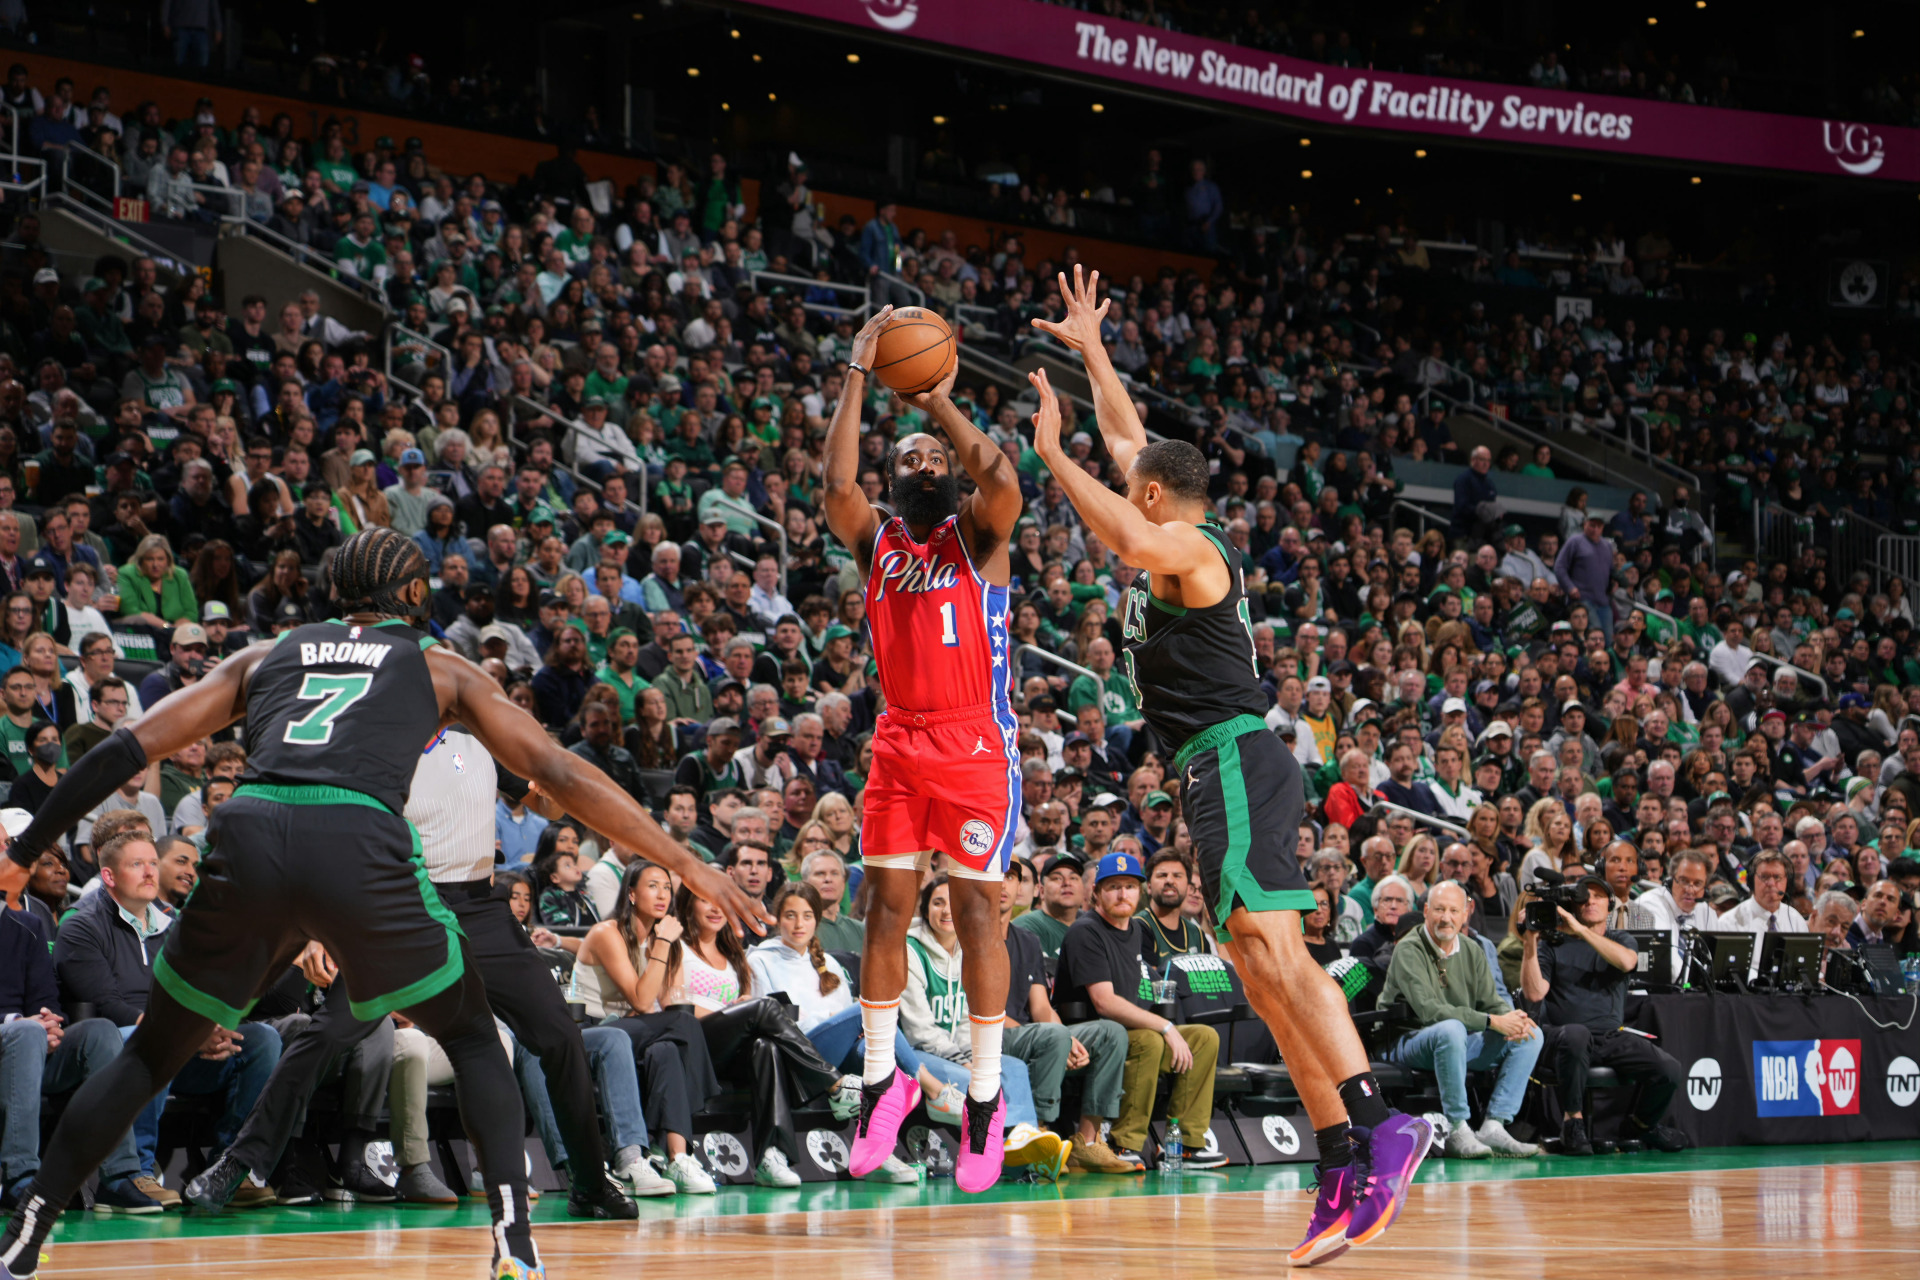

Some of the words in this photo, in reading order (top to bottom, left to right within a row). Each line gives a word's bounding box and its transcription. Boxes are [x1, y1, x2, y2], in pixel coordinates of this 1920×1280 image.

[1075, 21, 1129, 66] The
[1133, 34, 1195, 80] New
[1198, 49, 1325, 107] Standard
[1328, 77, 1368, 120] of
[1368, 80, 1494, 134] Facility
[1500, 95, 1633, 141] Services
[1823, 120, 1885, 159] UG2
[119, 198, 144, 223] EXIT
[874, 549, 960, 602] Phila
[939, 601, 960, 647] 1
[300, 641, 392, 668] BROWN
[282, 672, 374, 745] 7
[962, 828, 988, 850] 76ers
[1116, 856, 1127, 872] S
[1761, 1055, 1799, 1101] NBA
